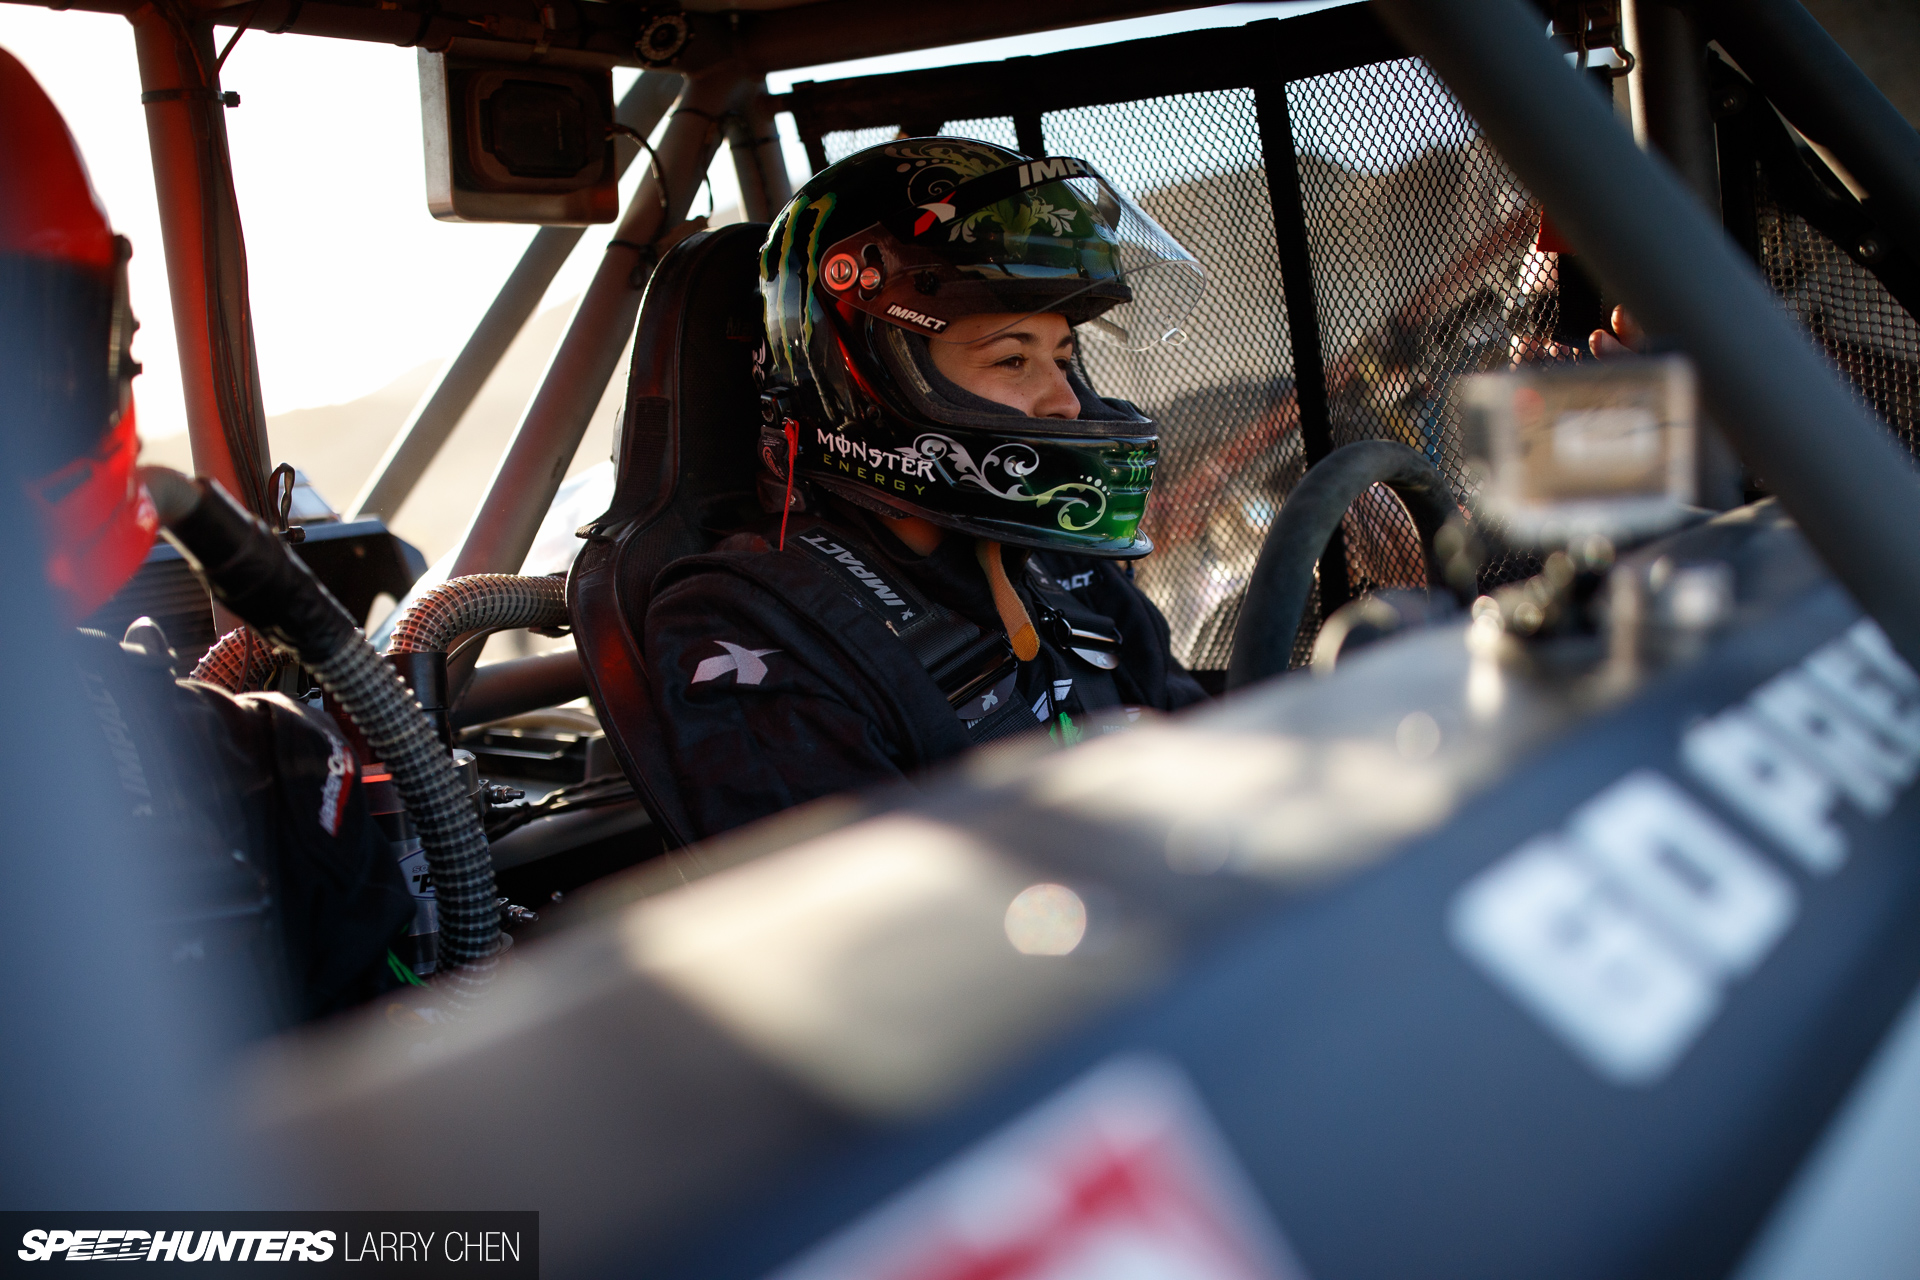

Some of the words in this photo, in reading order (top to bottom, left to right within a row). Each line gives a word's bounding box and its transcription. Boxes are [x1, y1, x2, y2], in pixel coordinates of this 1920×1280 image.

[886, 304, 947, 330] IMPACT
[816, 428, 937, 482] MONSTER
[823, 453, 925, 496] ENERGY
[799, 534, 907, 606] IMPACT
